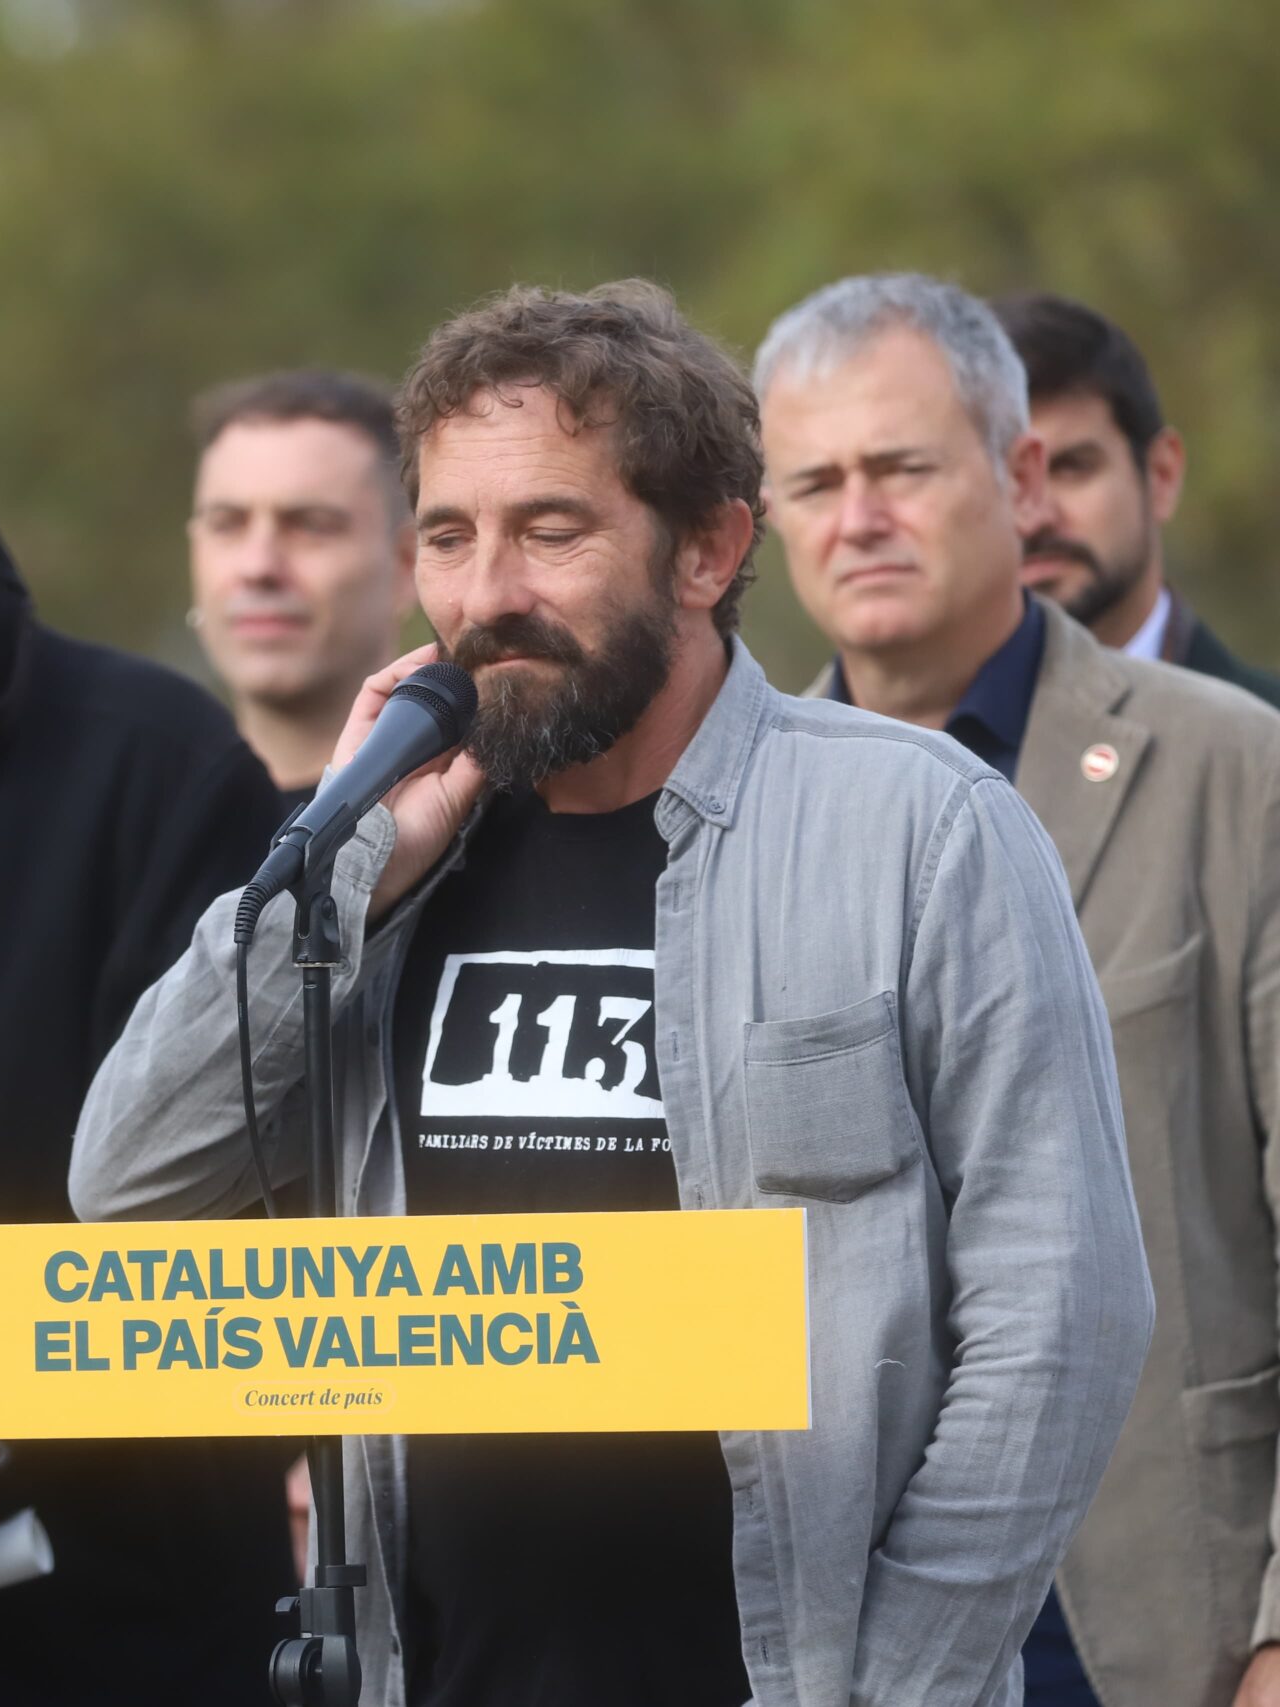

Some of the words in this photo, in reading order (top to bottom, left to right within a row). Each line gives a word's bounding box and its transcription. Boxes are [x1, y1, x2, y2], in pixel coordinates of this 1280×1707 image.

[487, 993, 652, 1094] 113
[418, 1134, 489, 1150] FAMILIARS
[492, 1135, 514, 1150] DE
[518, 1131, 591, 1151] VÍCTIMES
[595, 1136, 617, 1151] DE
[624, 1137, 644, 1152] LA
[44, 1246, 423, 1303] CATALUNYA
[432, 1242, 584, 1296] AMB
[35, 1320, 110, 1372] EL
[123, 1306, 264, 1371] PAÍS
[274, 1301, 601, 1369] VALENCIÀ
[244, 1389, 315, 1407] Concert
[319, 1388, 341, 1406] de
[344, 1387, 383, 1409] país
